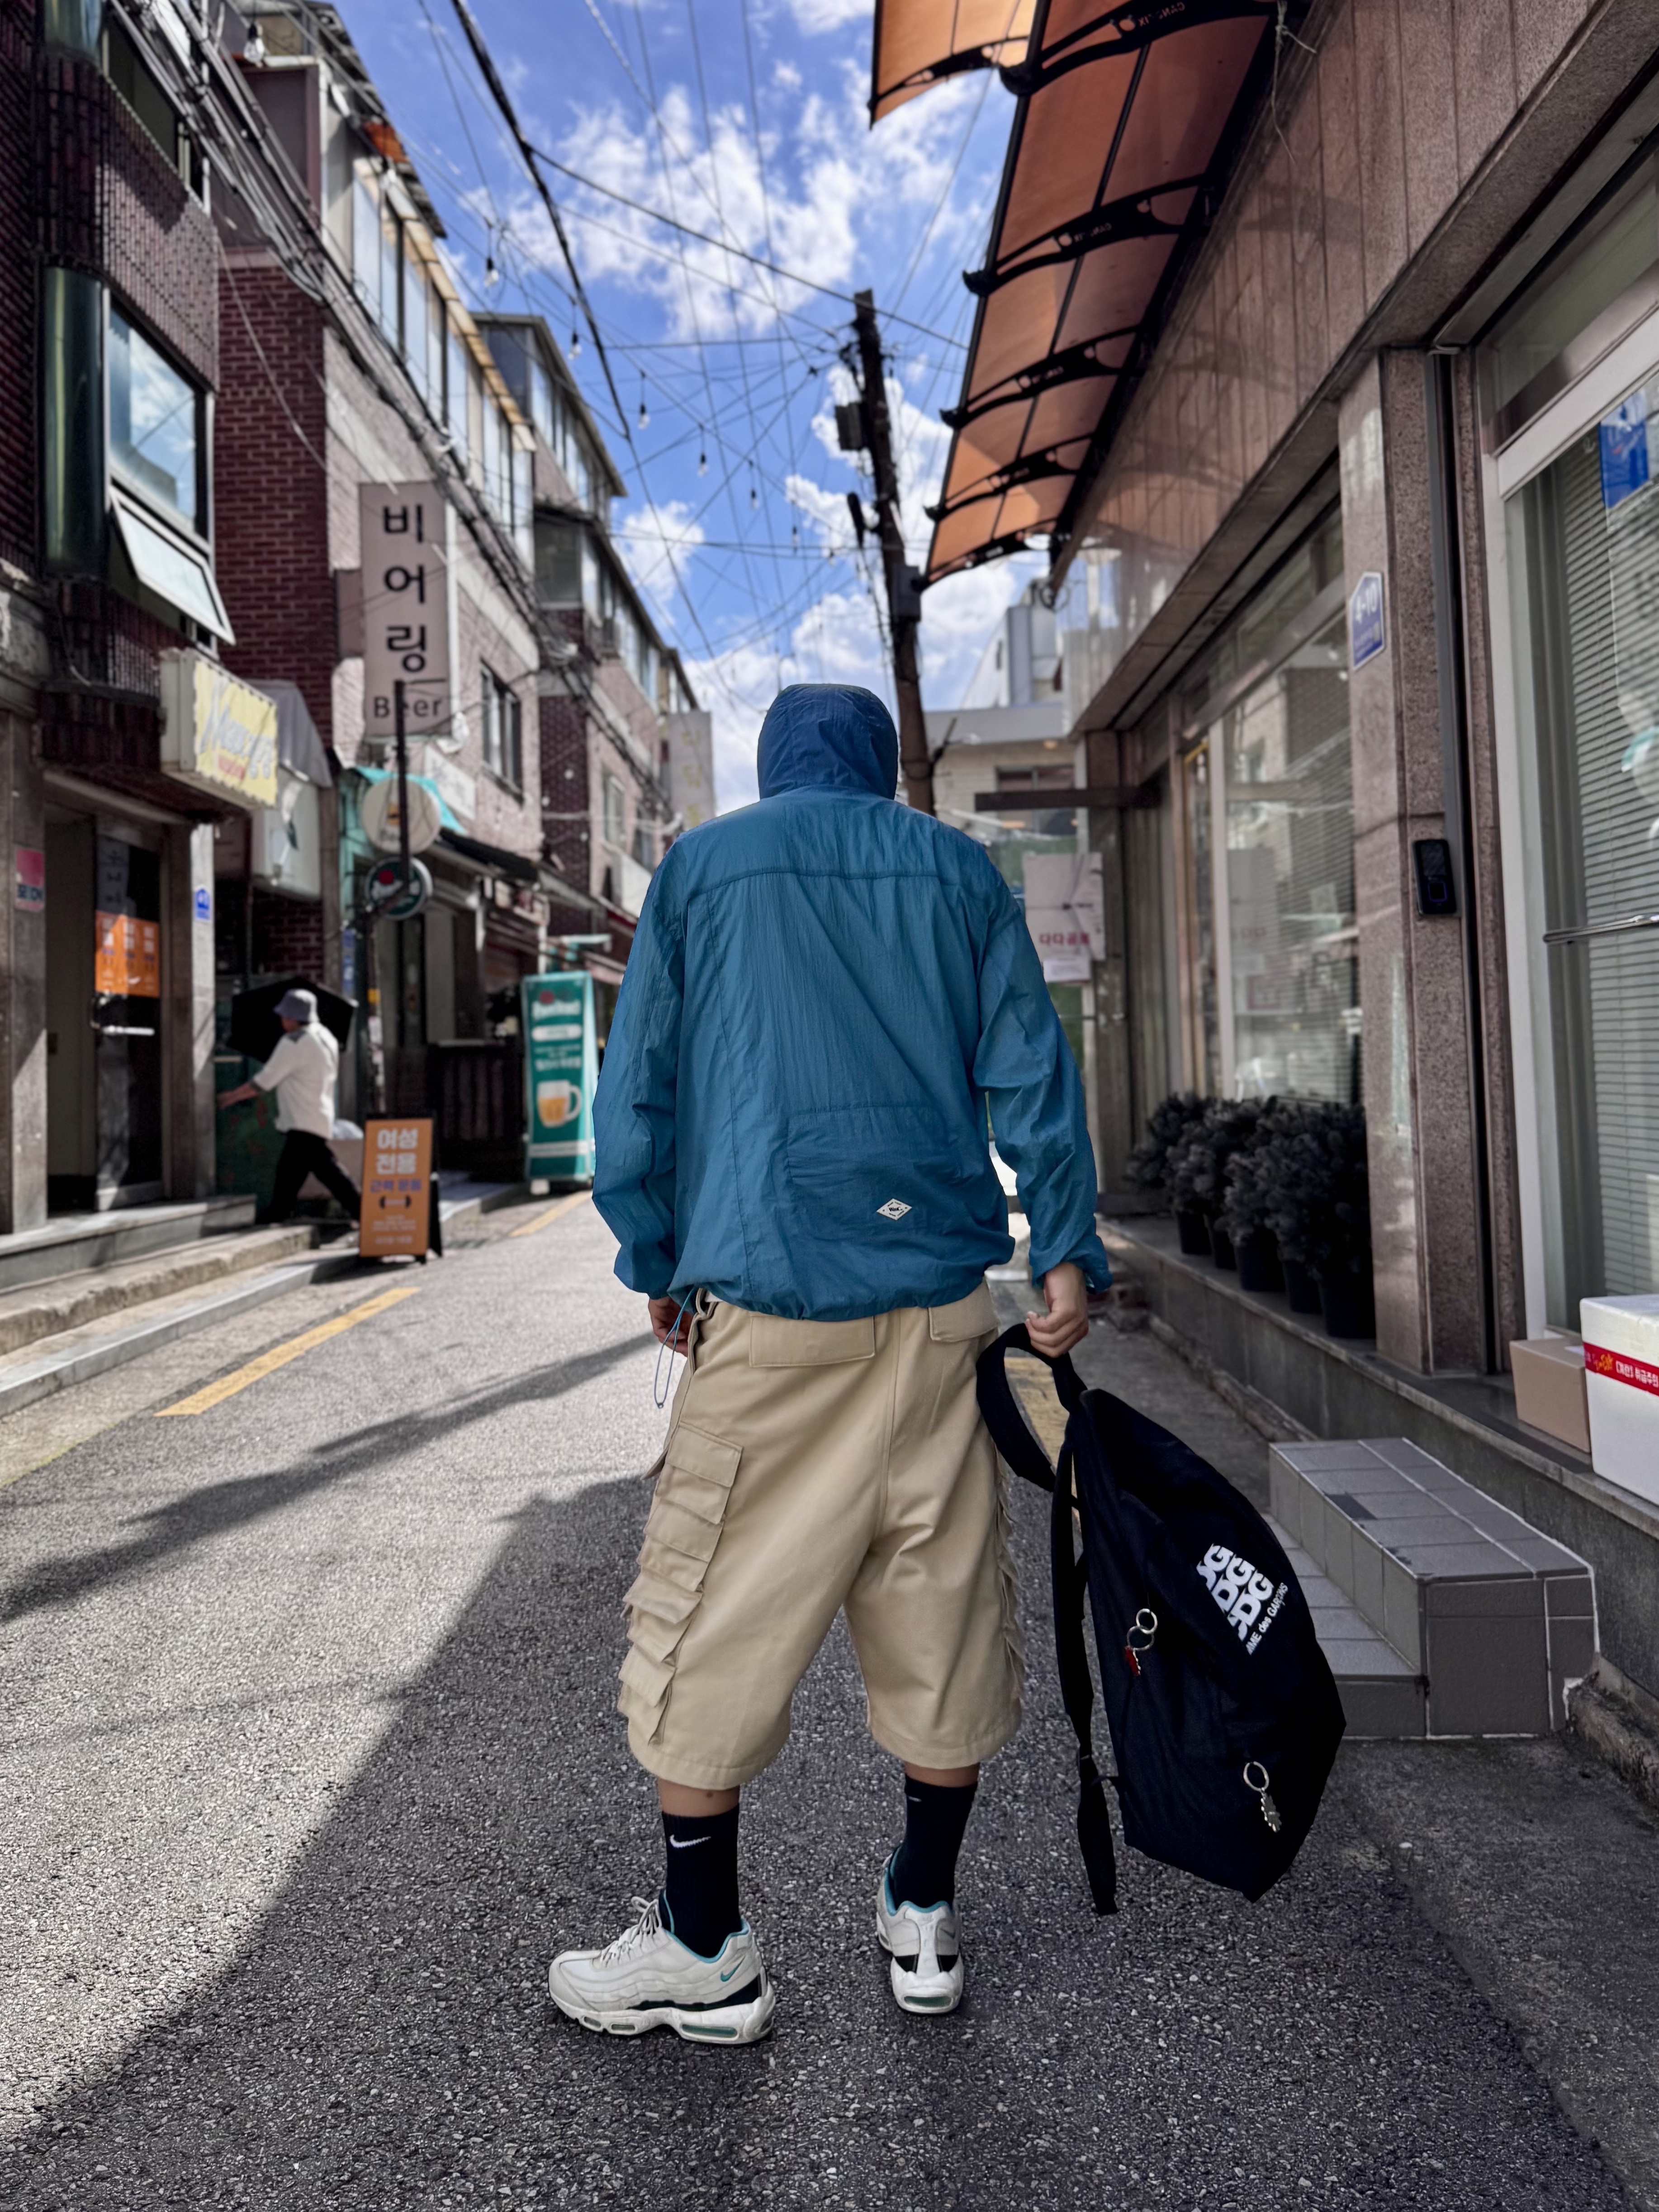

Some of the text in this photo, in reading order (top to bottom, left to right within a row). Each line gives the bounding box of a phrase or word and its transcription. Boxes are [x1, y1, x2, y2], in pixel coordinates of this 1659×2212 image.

[383, 504, 426, 673] 비어링
[1356, 583, 1377, 623] 4-10
[374, 695, 442, 719] Ber
[1258, 1616, 1272, 1634] des
